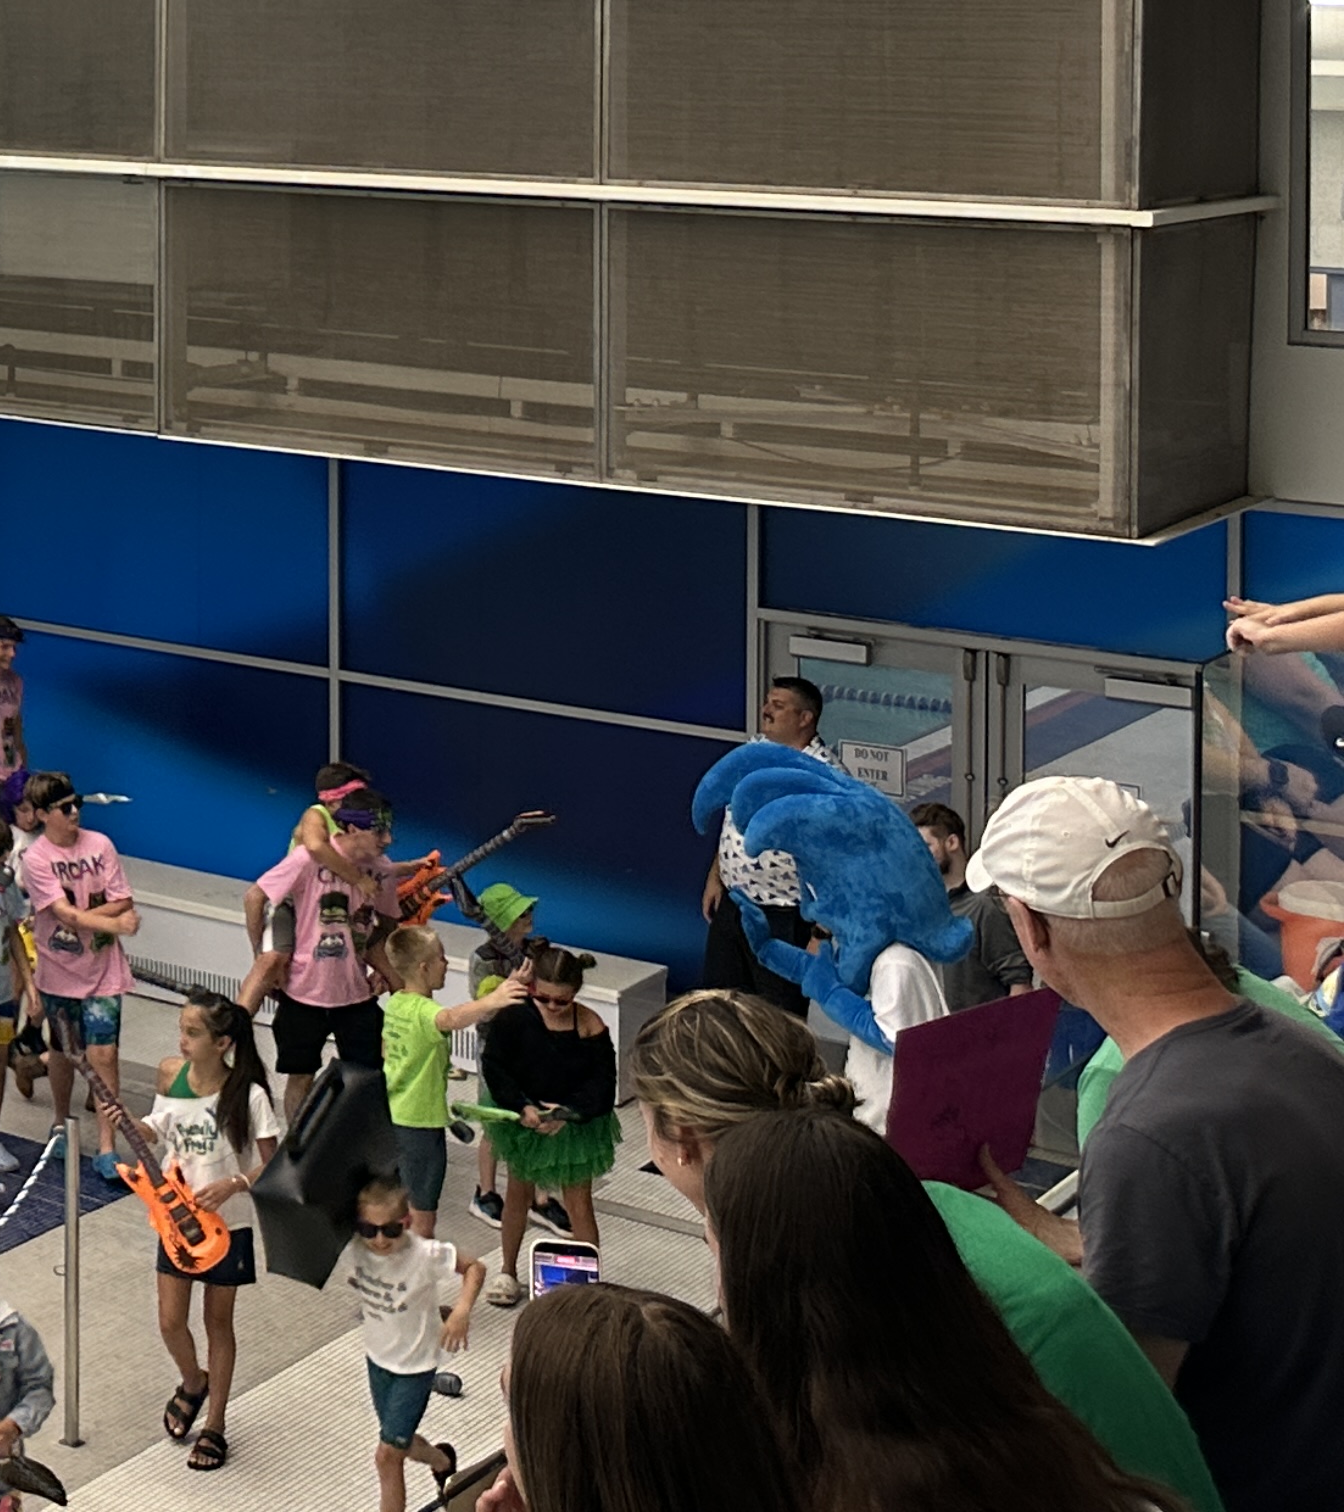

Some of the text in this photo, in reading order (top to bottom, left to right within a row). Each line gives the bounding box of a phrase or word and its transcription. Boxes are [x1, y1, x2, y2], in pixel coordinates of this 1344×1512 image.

[854, 748, 889, 762] DO NOT
[857, 767, 888, 781] ENTER
